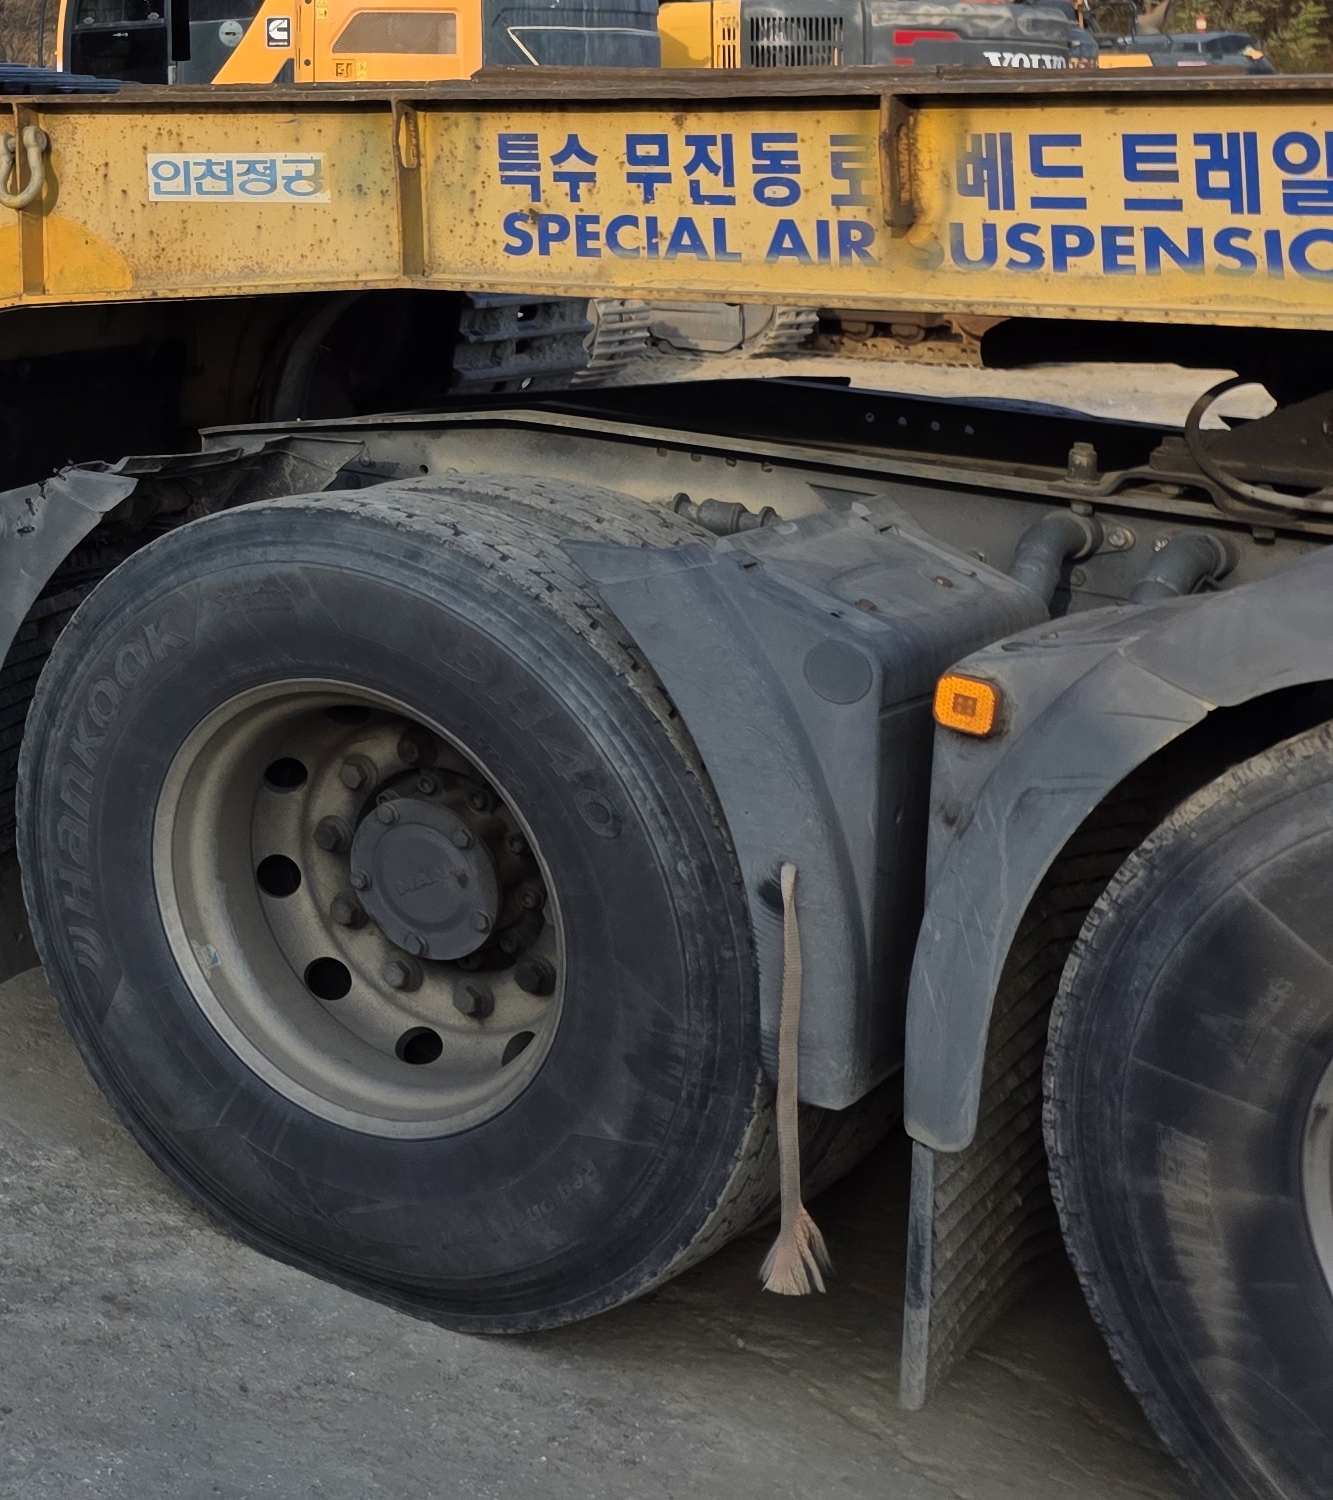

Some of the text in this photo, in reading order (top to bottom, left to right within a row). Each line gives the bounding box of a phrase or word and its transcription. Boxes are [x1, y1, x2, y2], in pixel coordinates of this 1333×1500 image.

[150, 157, 327, 198] 인천정공
[497, 132, 599, 203] 특수
[625, 132, 802, 208] 무진동
[830, 132, 1088, 211] 로베드
[502, 211, 743, 263] SPECIAL
[764, 217, 881, 267] AIR
